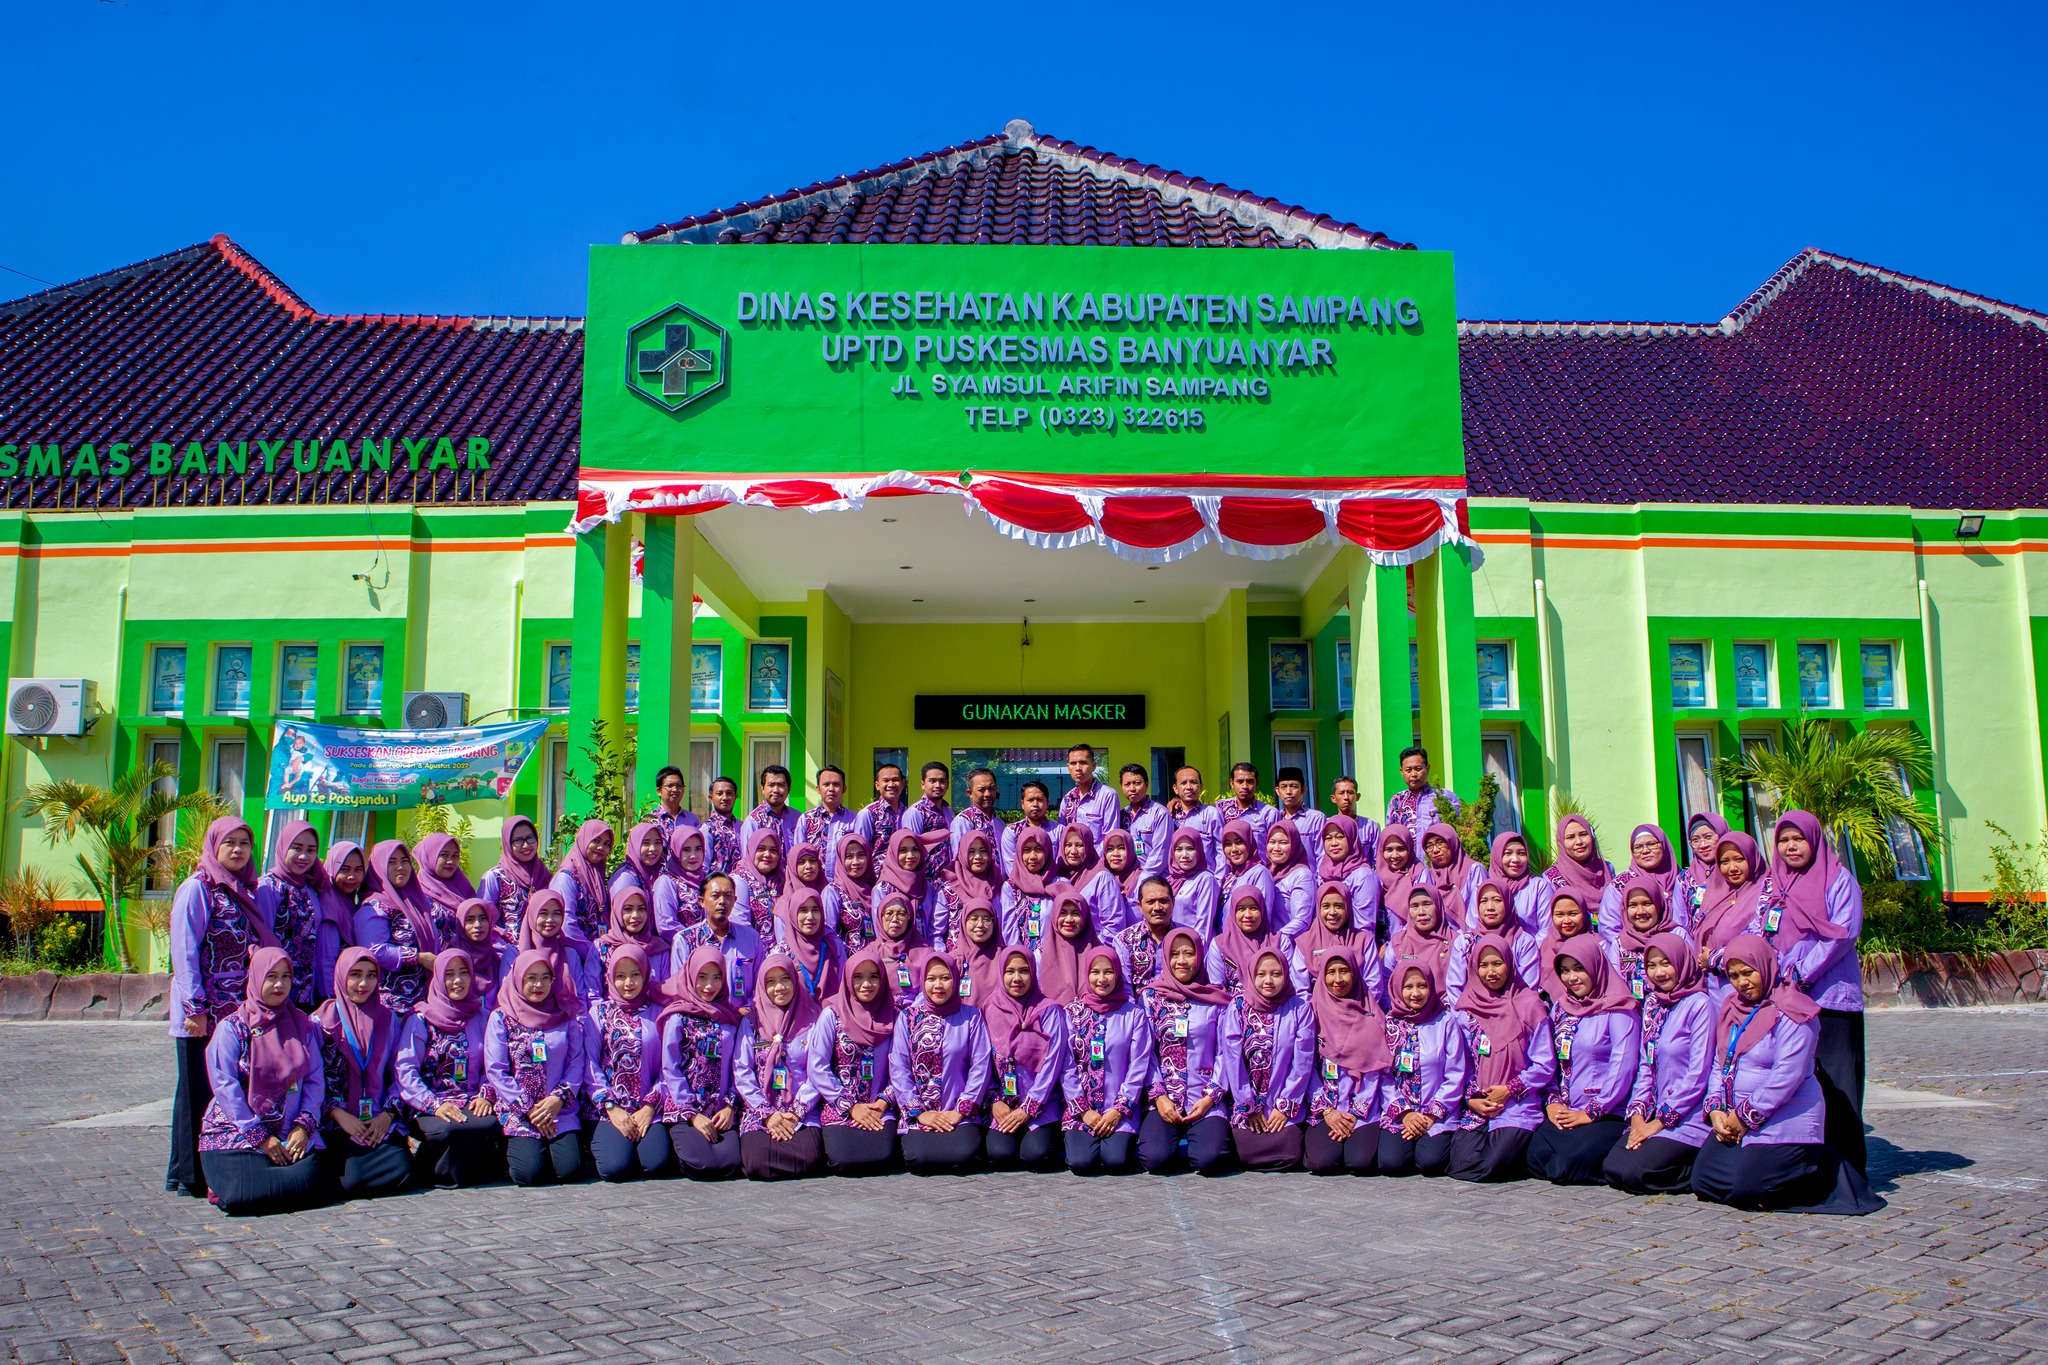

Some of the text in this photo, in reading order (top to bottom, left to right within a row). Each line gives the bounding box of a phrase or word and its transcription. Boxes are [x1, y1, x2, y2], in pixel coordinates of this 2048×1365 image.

[737, 291, 1420, 326] DINAS KESEHATAN KABUPATEN SAMPANG
[822, 335, 1333, 367] UPTD PUSKESMAS BANYUANYAR
[891, 374, 1269, 397] JL SYAMSUL ARIFIN SAMPANG
[965, 406, 1204, 429] TELP (0323) 322615
[149, 437, 491, 476] BANYUANYAR
[962, 704, 1126, 720] GUNAKAN MASKER
[325, 745, 498, 758] SUKSESKAN OPERASI TIMBANG
[282, 790, 307, 806] Ayo
[310, 792, 326, 804] Ke
[328, 792, 389, 807] Posyandu
